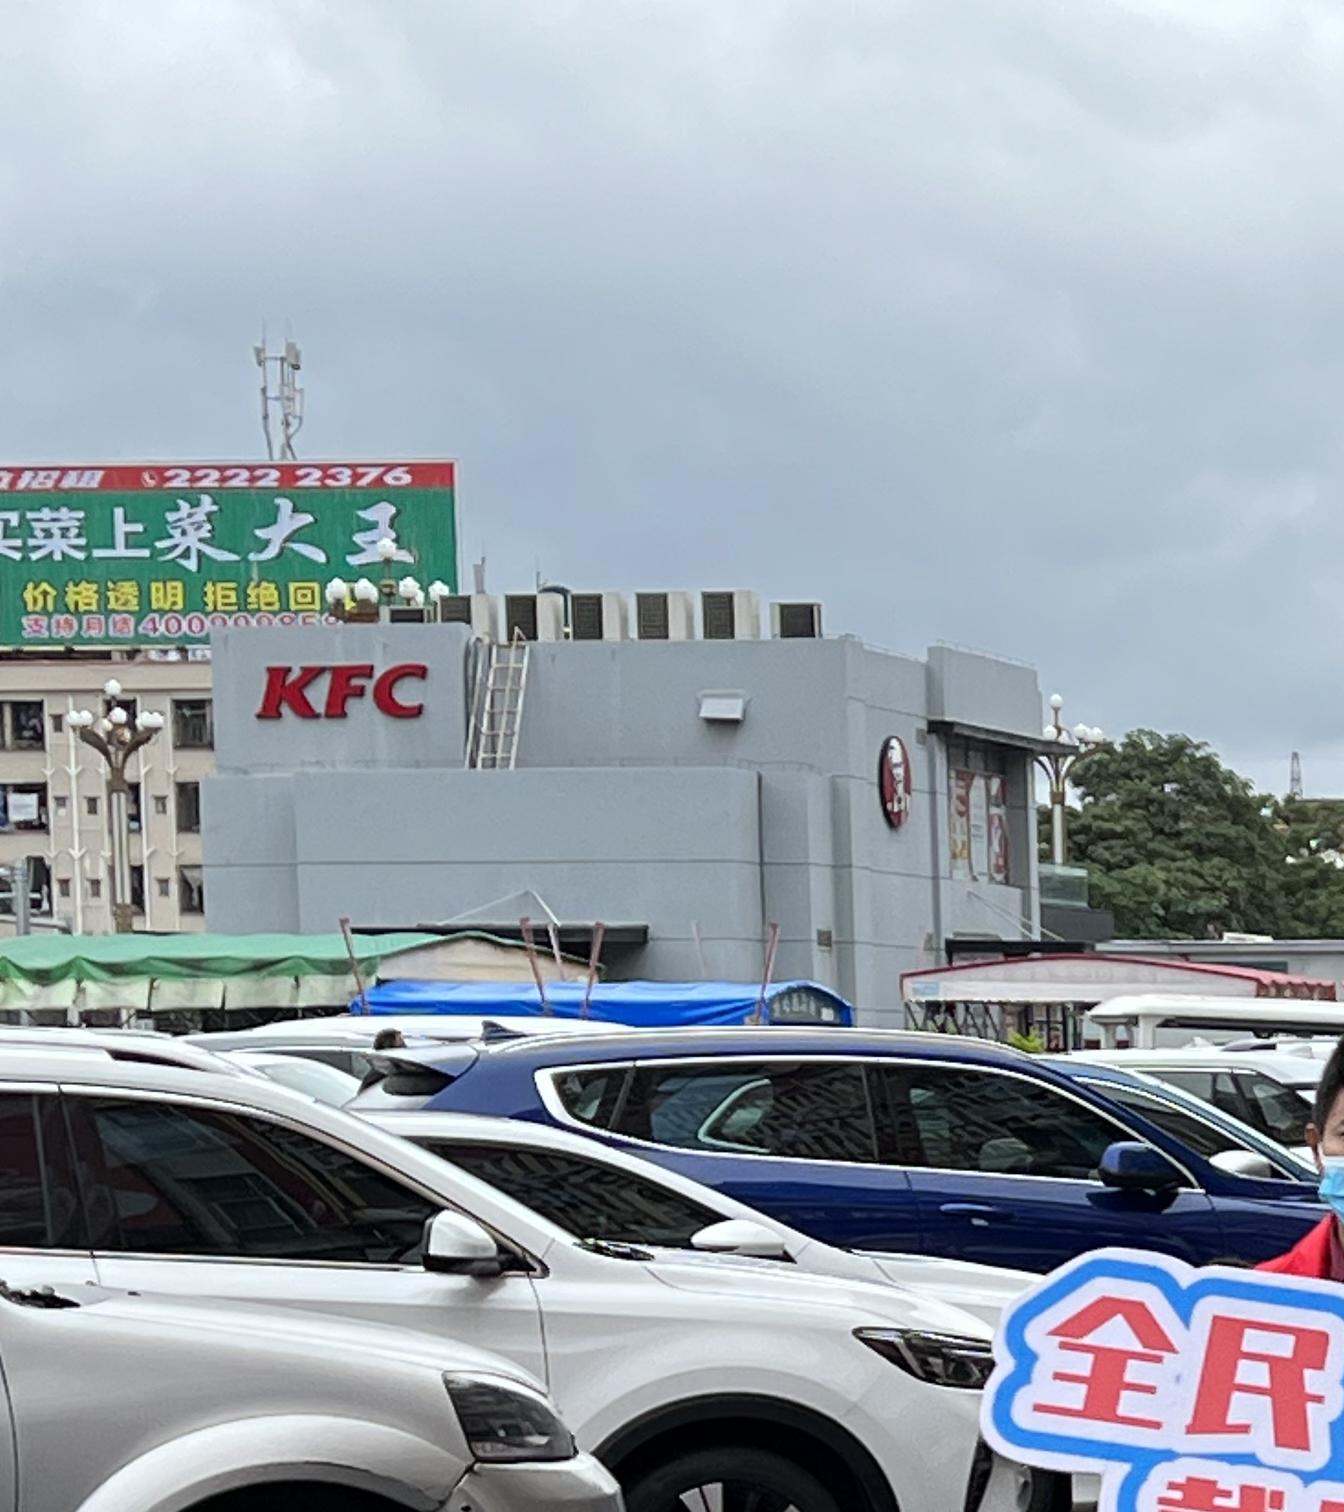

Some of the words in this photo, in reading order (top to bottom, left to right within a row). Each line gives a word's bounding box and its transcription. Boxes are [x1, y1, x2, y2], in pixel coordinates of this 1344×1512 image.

[163, 468, 281, 489] 2222
[294, 466, 413, 487] 2376
[22, 580, 184, 612] 价格透明
[203, 580, 357, 612] 拒绝回
[256, 663, 429, 720] KFC
[1031, 1294, 1331, 1453] 全民
